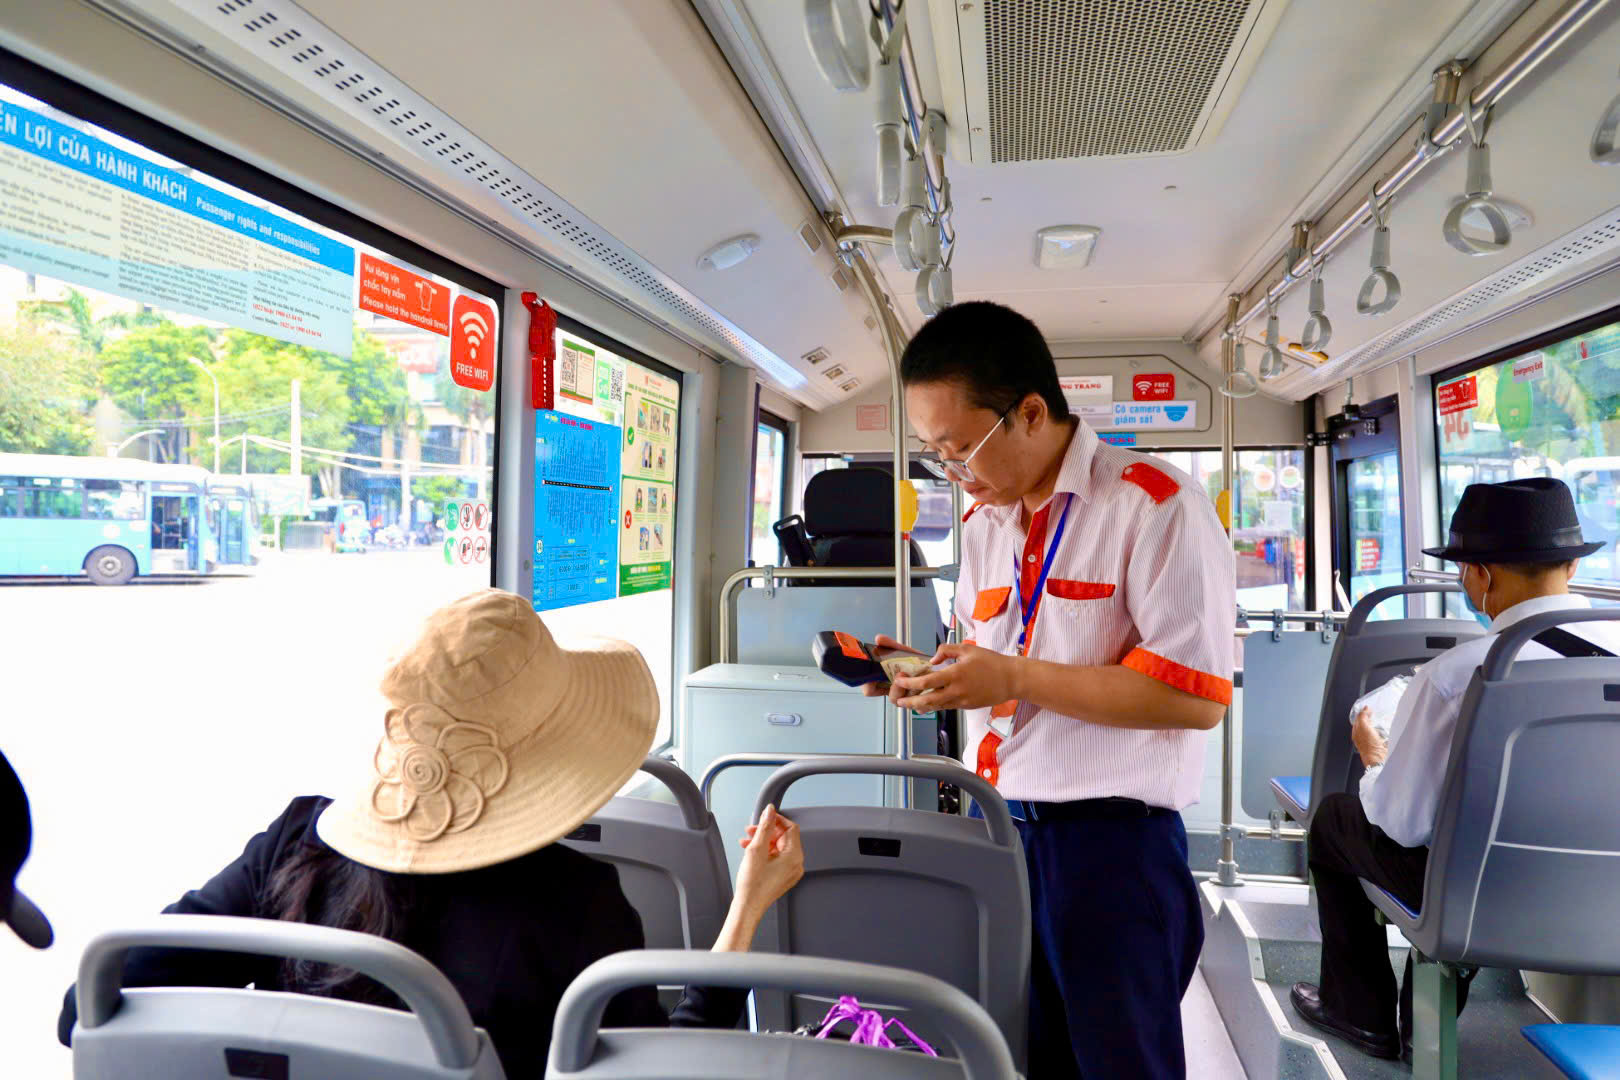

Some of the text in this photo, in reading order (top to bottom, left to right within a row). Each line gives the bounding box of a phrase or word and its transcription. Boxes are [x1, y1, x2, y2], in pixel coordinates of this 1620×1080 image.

[25, 122, 52, 149] LỢI
[58, 134, 91, 165] CỦA
[96, 150, 138, 183] HÀNH
[143, 170, 188, 203] KHÁCH
[196, 196, 235, 222] Passenger
[237, 214, 258, 232] rights
[259, 223, 272, 237] and
[273, 230, 320, 256] responsibilities
[364, 263, 400, 285] Vui lòng vịn
[381, 284, 391, 297] tay
[363, 296, 384, 310] Please
[385, 302, 399, 314] hold
[399, 307, 409, 318] the
[410, 310, 433, 326] handrail
[456, 362, 489, 381] FREE WIFI
[1513, 361, 1543, 377] Emergency Exit
[1114, 404, 1161, 413] Có camera
[1114, 414, 1153, 425] giám sát
